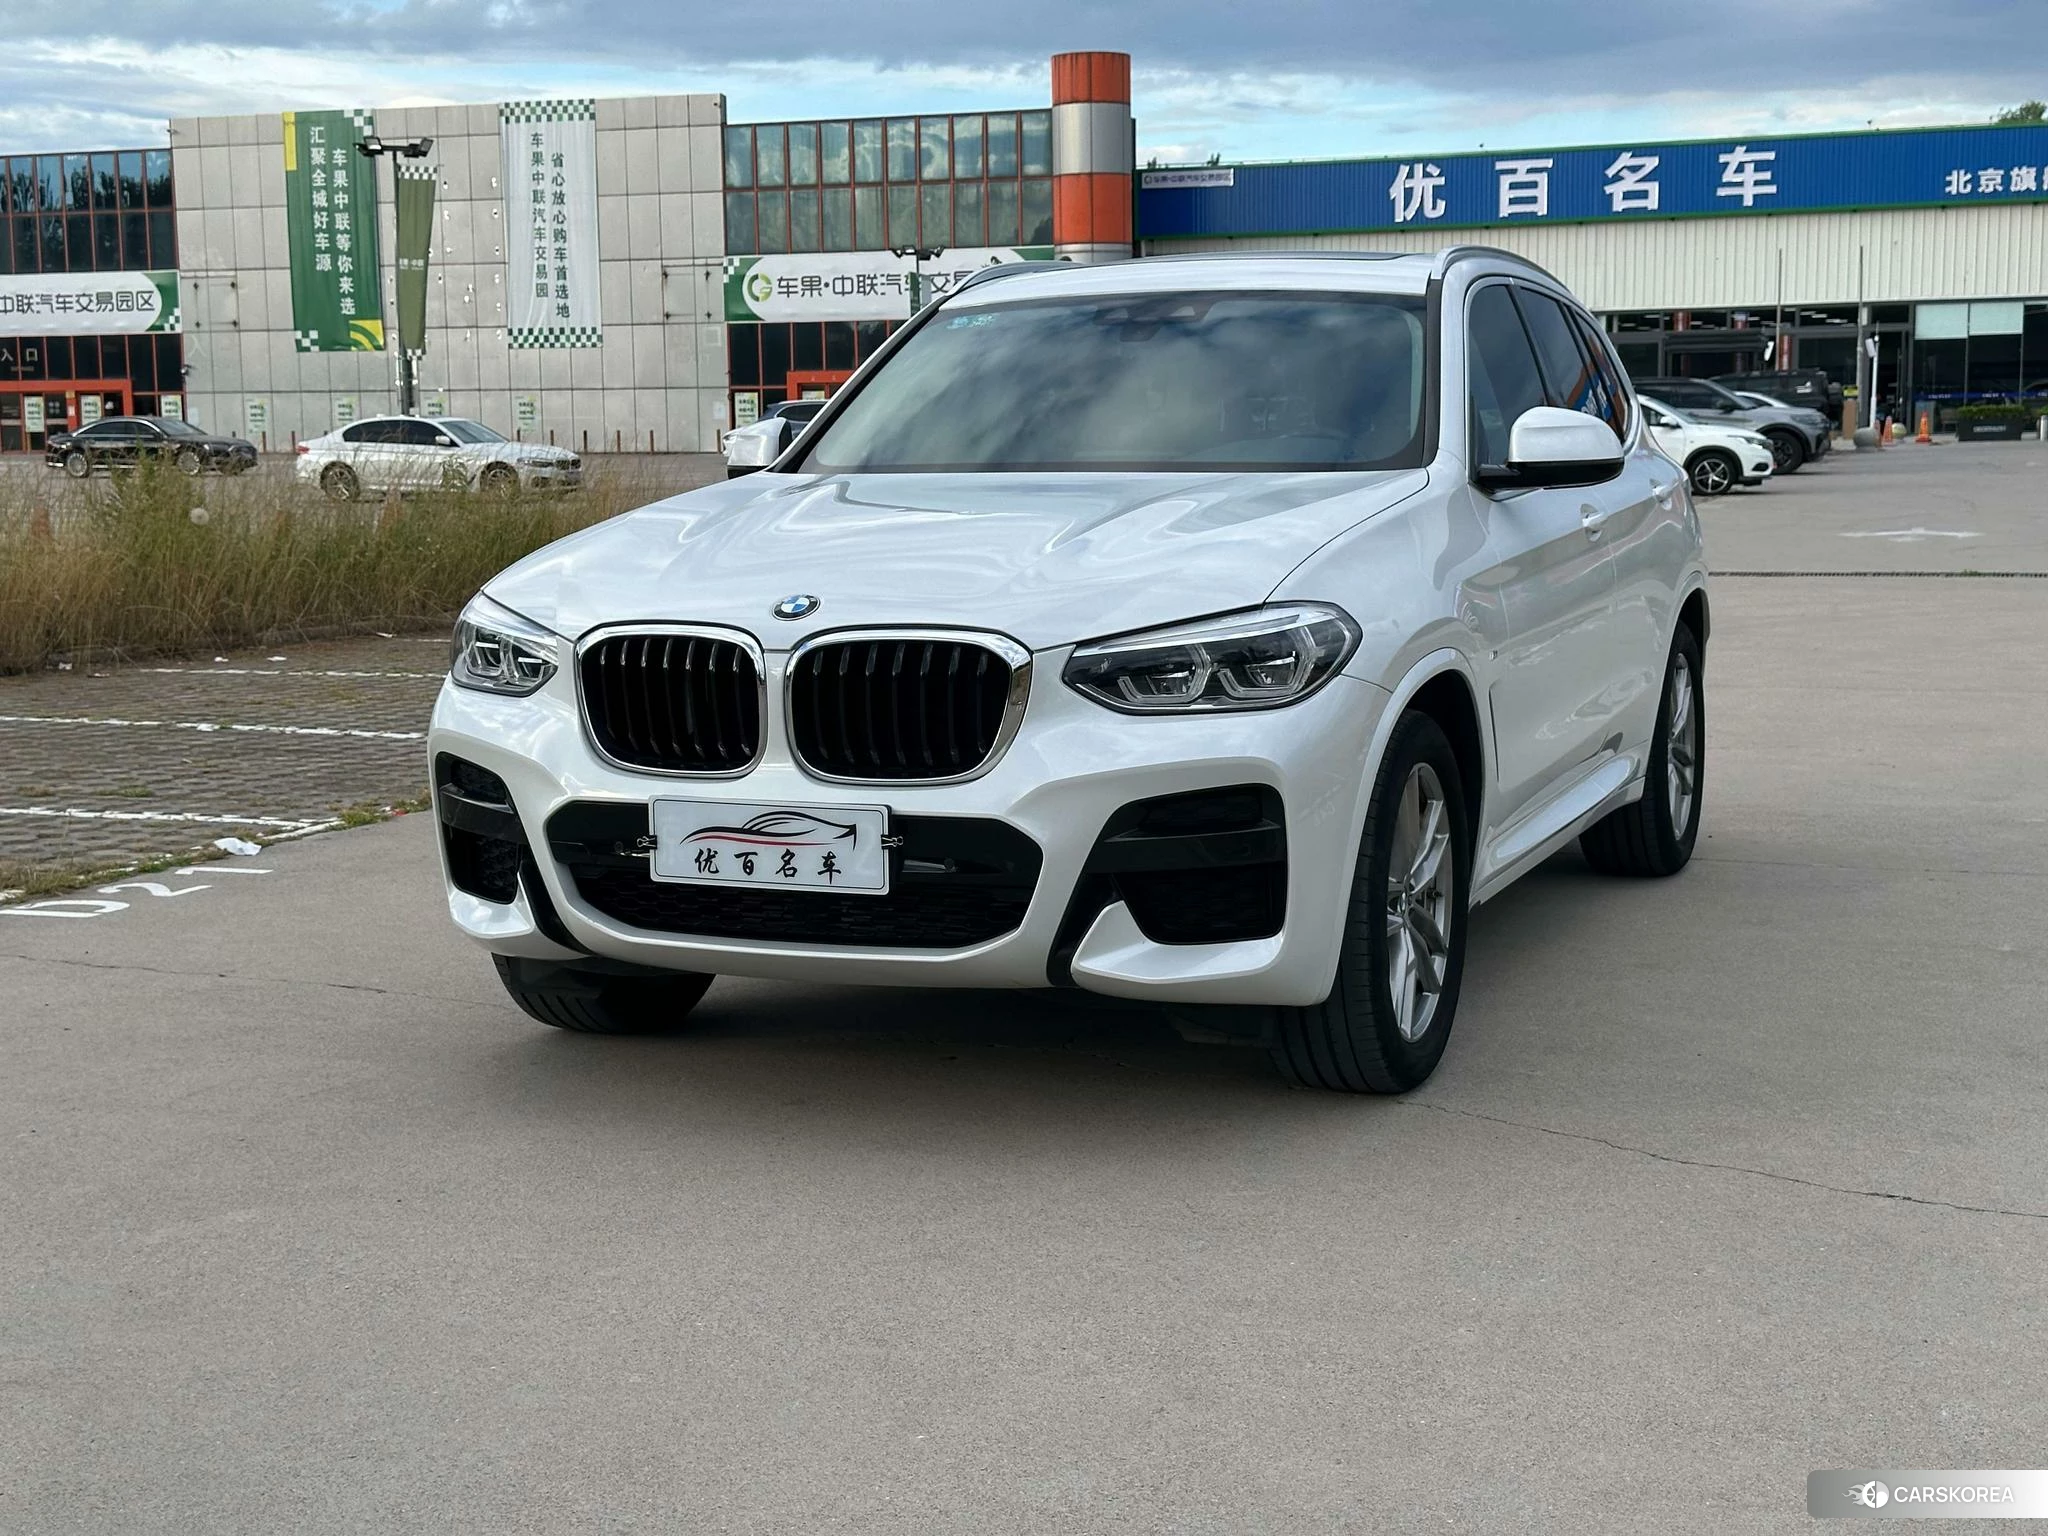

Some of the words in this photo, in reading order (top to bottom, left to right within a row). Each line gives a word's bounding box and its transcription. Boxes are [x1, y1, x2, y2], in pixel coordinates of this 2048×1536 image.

[310, 126, 332, 272] 汇聚全城好车源
[331, 149, 356, 315] 车果中联等你来选
[530, 132, 548, 298] 车果中联汽车交易园
[551, 152, 570, 319] 省心放心购车首选地
[1390, 145, 1778, 223] 优百名车
[0, 290, 155, 314] 中联汽车交易园区
[777, 271, 974, 298] 车果·中联汽交
[695, 848, 842, 884] 优百名车
